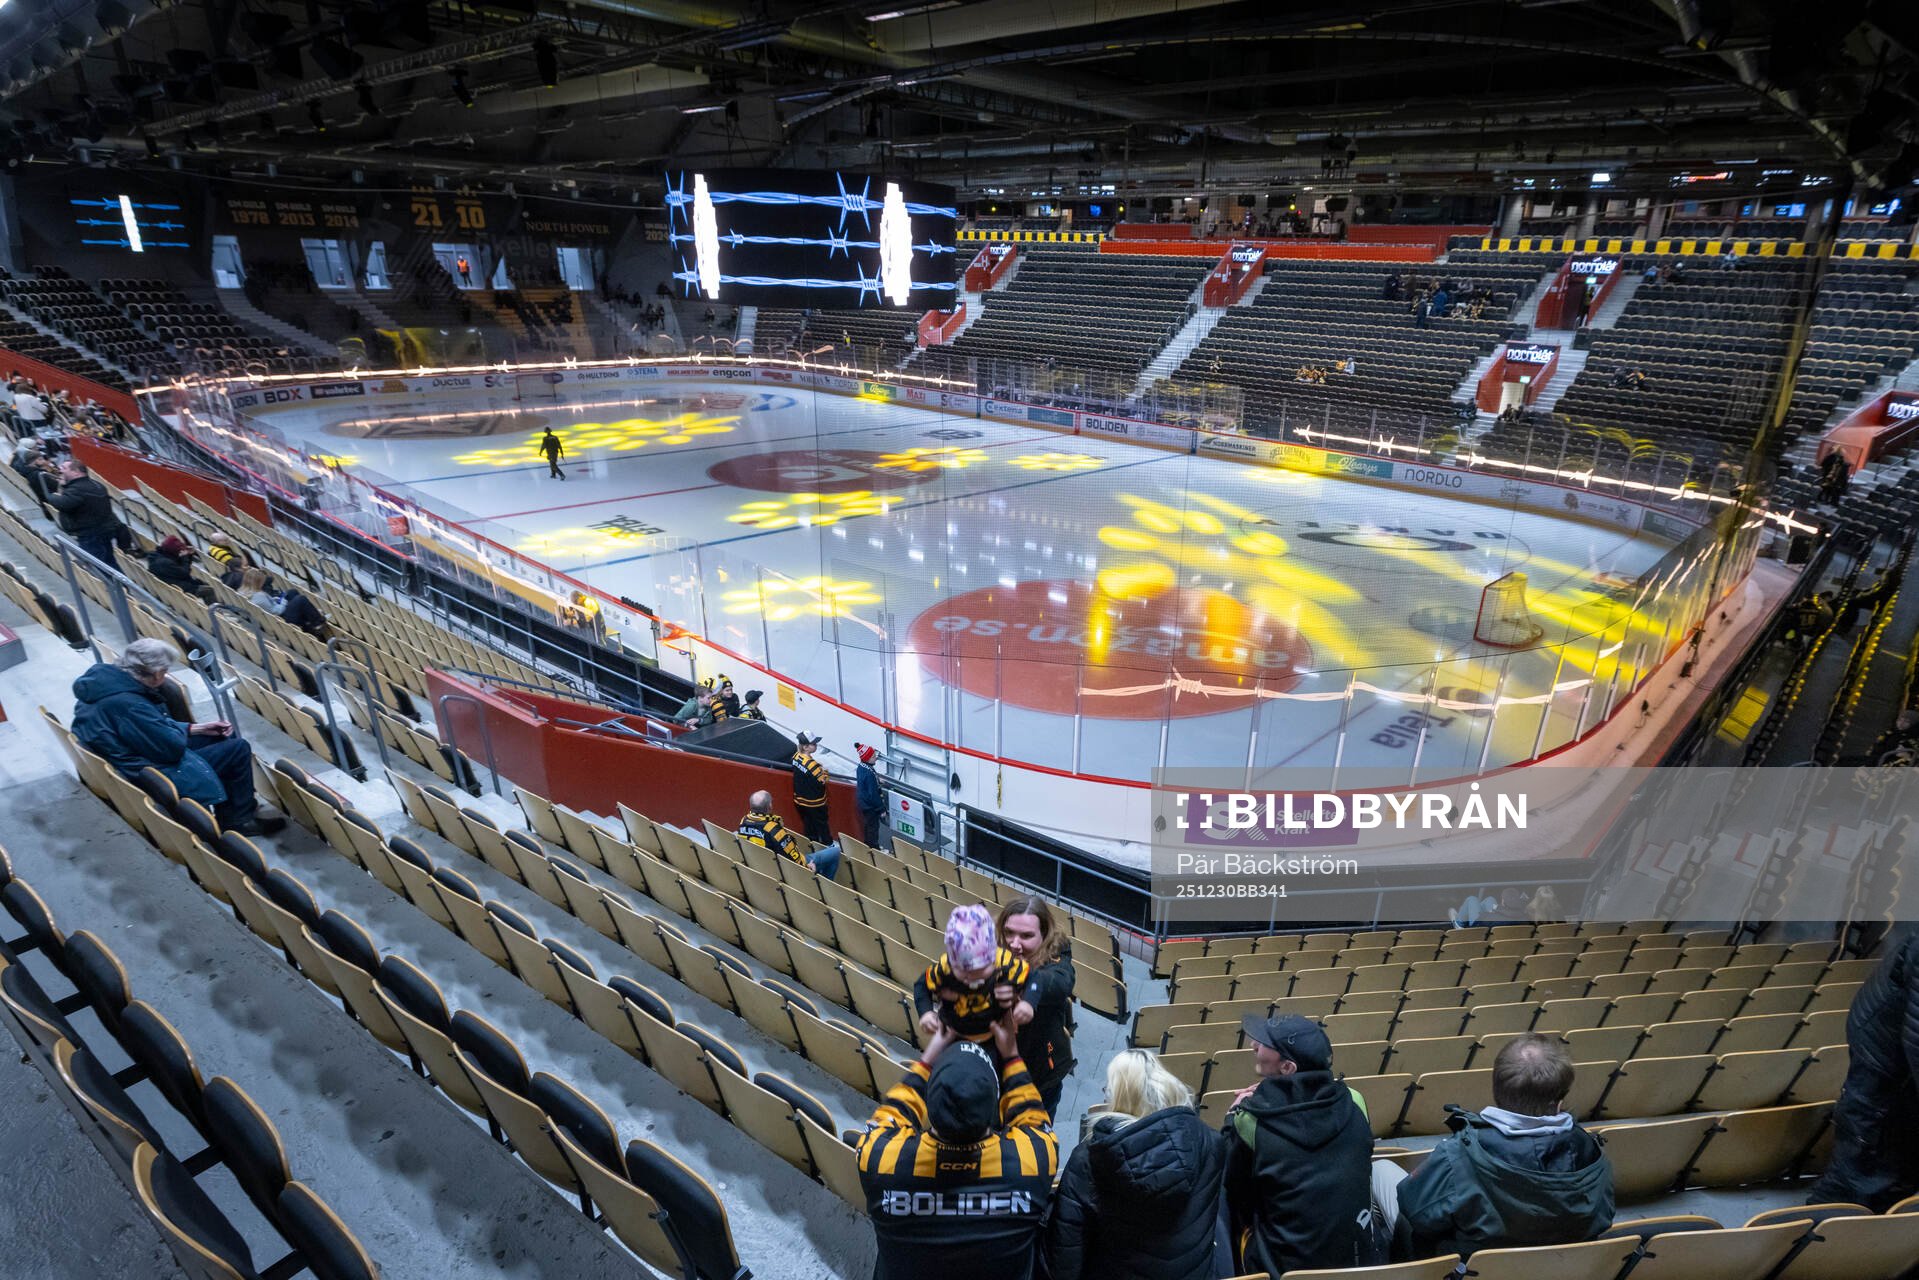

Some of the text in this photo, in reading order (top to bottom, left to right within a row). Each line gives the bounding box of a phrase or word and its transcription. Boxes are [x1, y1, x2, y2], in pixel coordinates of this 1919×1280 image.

[232, 209, 271, 225] 1978
[278, 212, 316, 226] 2013
[324, 214, 360, 228] 2014
[411, 203, 443, 228] 21
[455, 205, 486, 230] 10
[526, 222, 610, 235] NORTH POWER
[712, 369, 751, 378] engcon
[263, 387, 304, 404] BDX
[1085, 417, 1129, 434] BOLIDEN
[939, 1161, 978, 1171] CCM
[890, 1191, 1032, 1216] BOLIDEN
